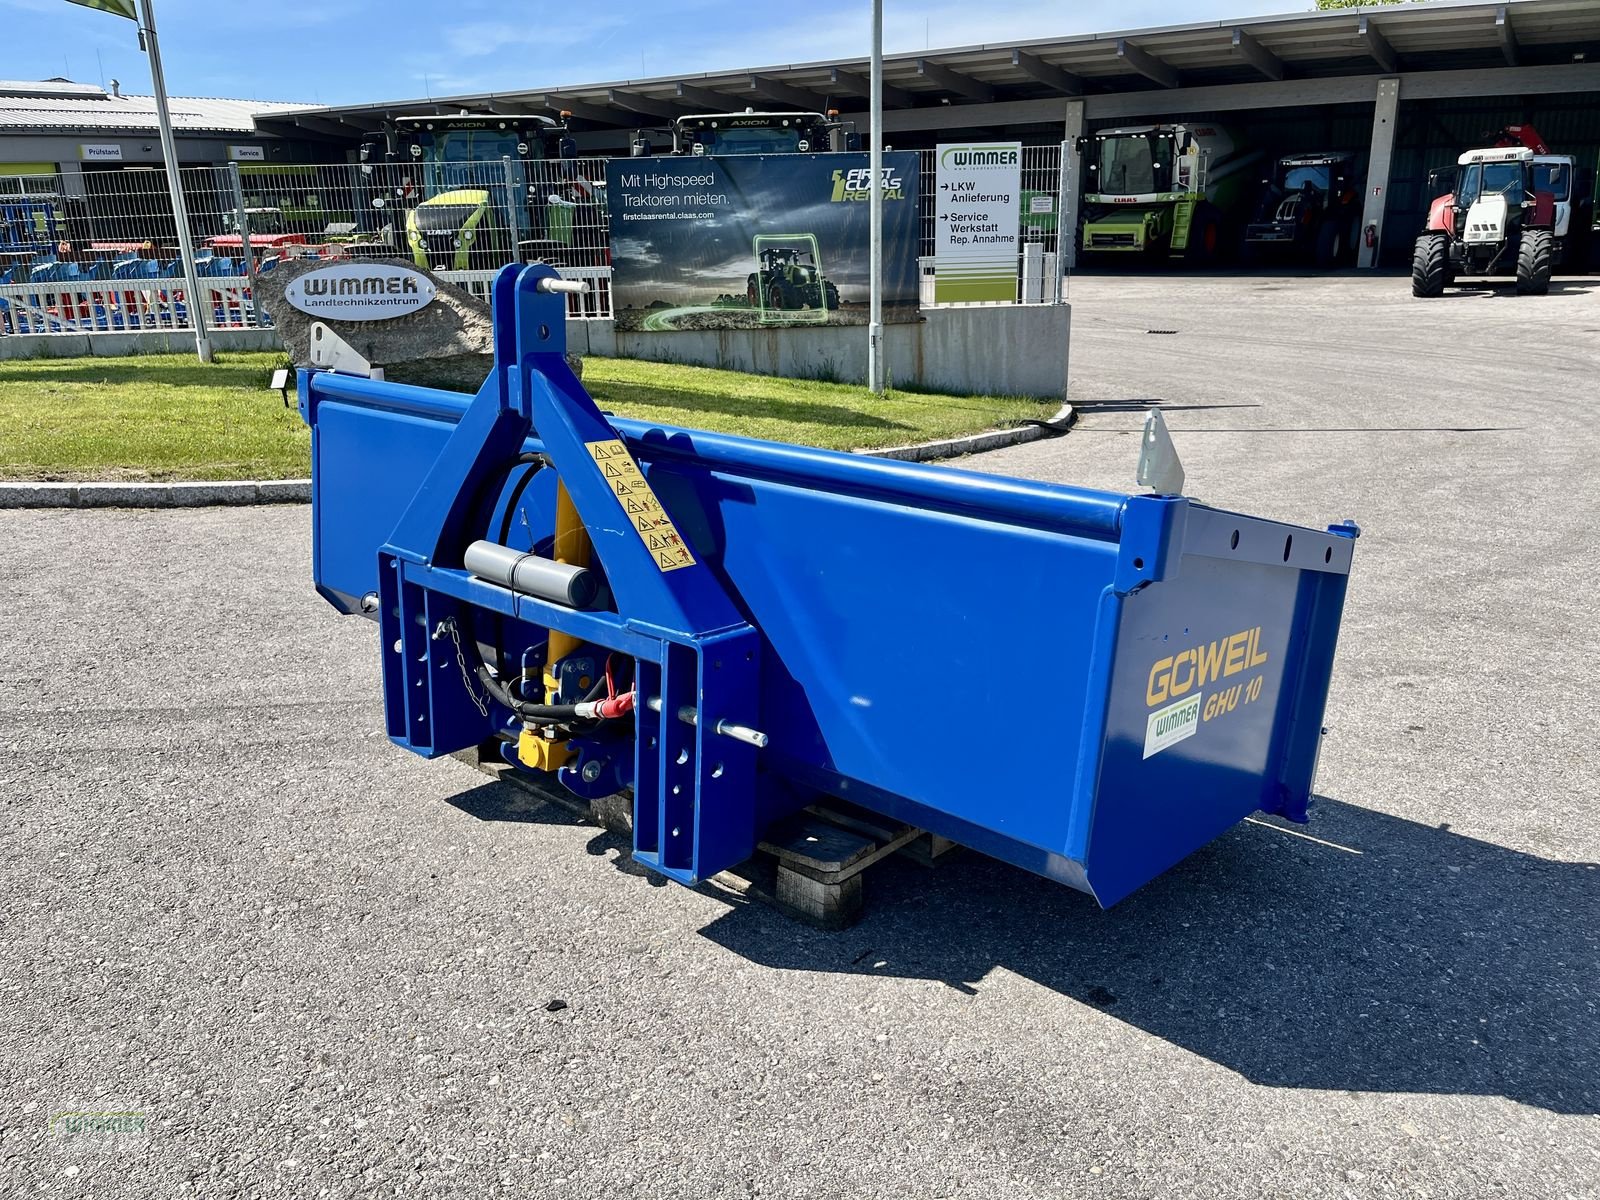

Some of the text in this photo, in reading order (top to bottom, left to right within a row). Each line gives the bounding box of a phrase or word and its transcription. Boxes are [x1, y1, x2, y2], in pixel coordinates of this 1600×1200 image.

[88, 148, 120, 156] Prüfstand
[954, 151, 1018, 165] WIMMER
[621, 172, 715, 190] Mit Highspeed
[951, 182, 976, 192] LKW
[621, 192, 730, 207] Traktoren mieten.
[951, 193, 1010, 204] Anlieferung
[623, 212, 715, 221] firstclaasrental.claas.com
[950, 212, 989, 222] Service
[950, 223, 999, 233] Werkstatt
[950, 234, 1015, 246] Rep. Annahme
[304, 276, 418, 296] WIMMER
[304, 297, 419, 307] Landtechnikzentrum
[1202, 674, 1263, 722] GHU 10
[1155, 703, 1199, 737] WIMMER
